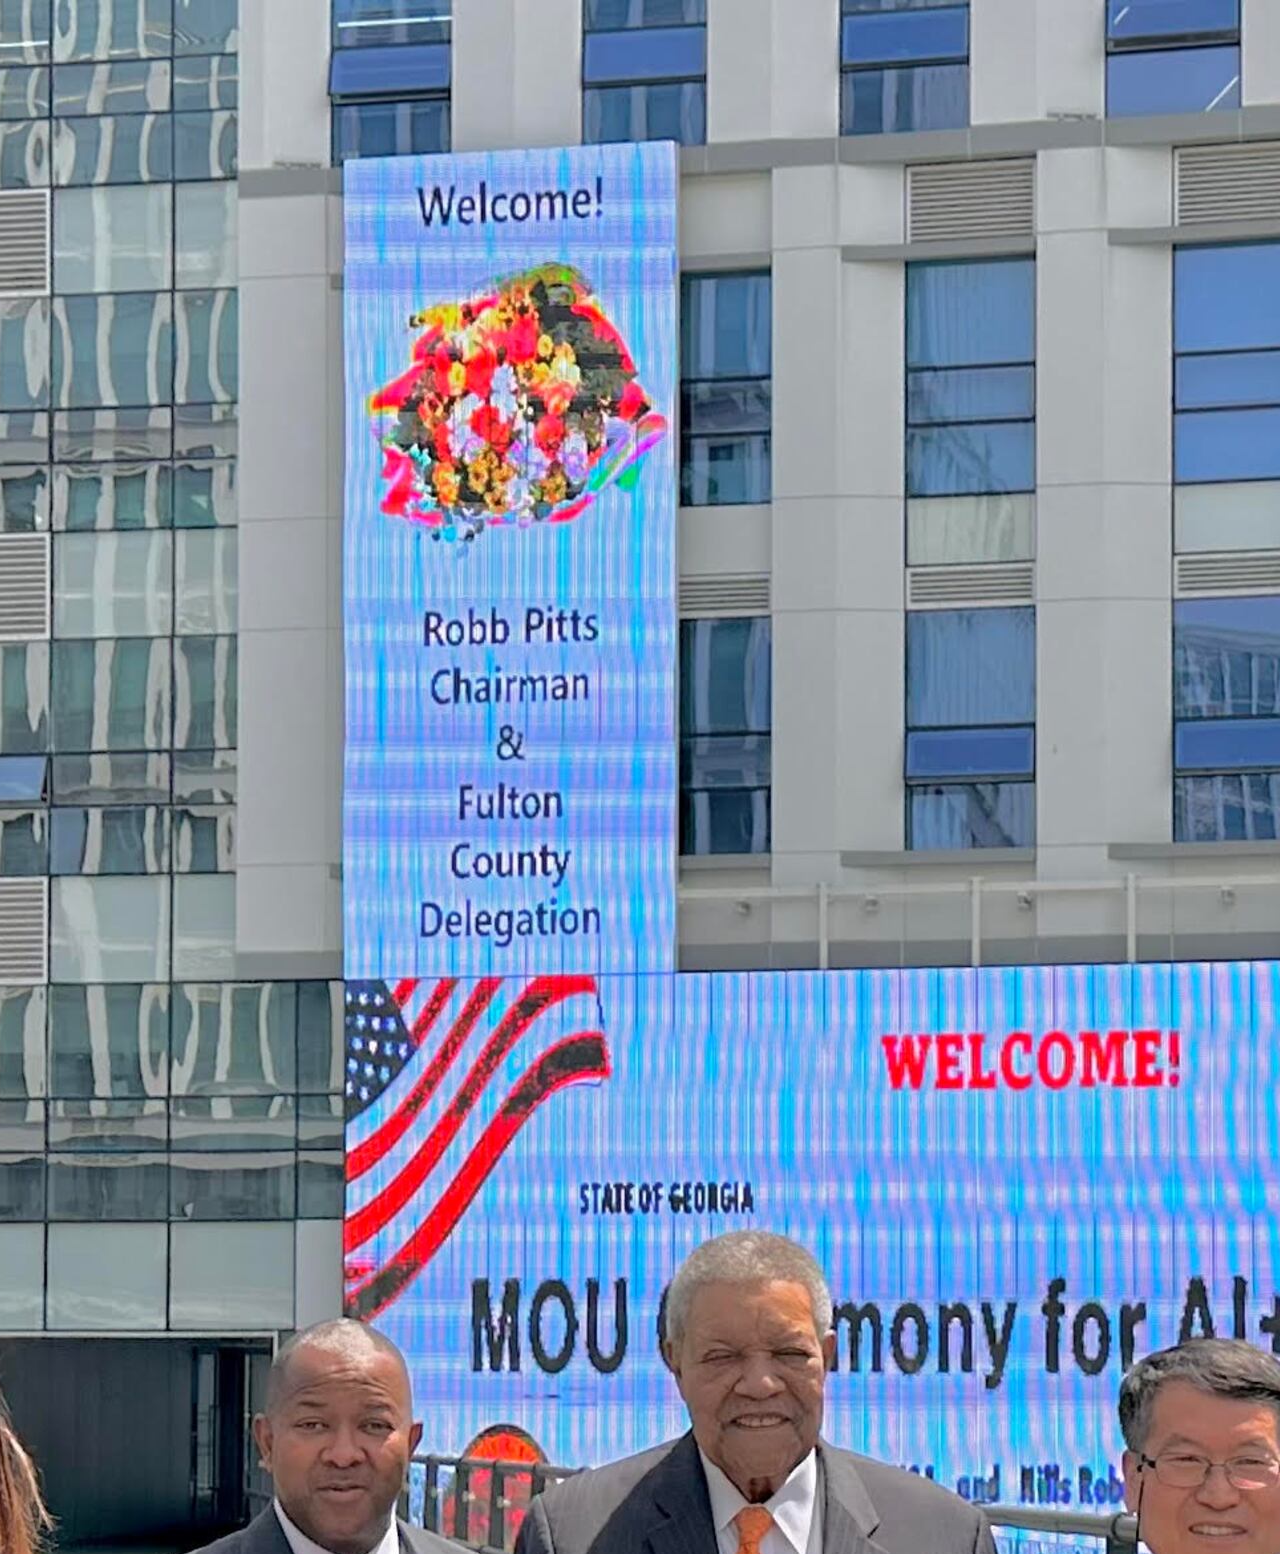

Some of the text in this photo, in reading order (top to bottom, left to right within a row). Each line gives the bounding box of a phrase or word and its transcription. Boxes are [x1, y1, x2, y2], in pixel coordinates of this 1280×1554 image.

[417, 176, 603, 227] Welcome!
[424, 605, 600, 647] Robb Pitts
[431, 666, 589, 705] Chairman
[497, 725, 526, 761] &
[458, 782, 563, 820] Fulton
[451, 843, 571, 888] County
[420, 897, 601, 947] Delegation
[880, 1031, 1180, 1090] WELCOME!
[580, 1181, 754, 1215] STATE OF GEORGIA
[471, 1278, 628, 1373] MOU
[1042, 1276, 1146, 1374] for
[956, 1463, 1000, 1503] and
